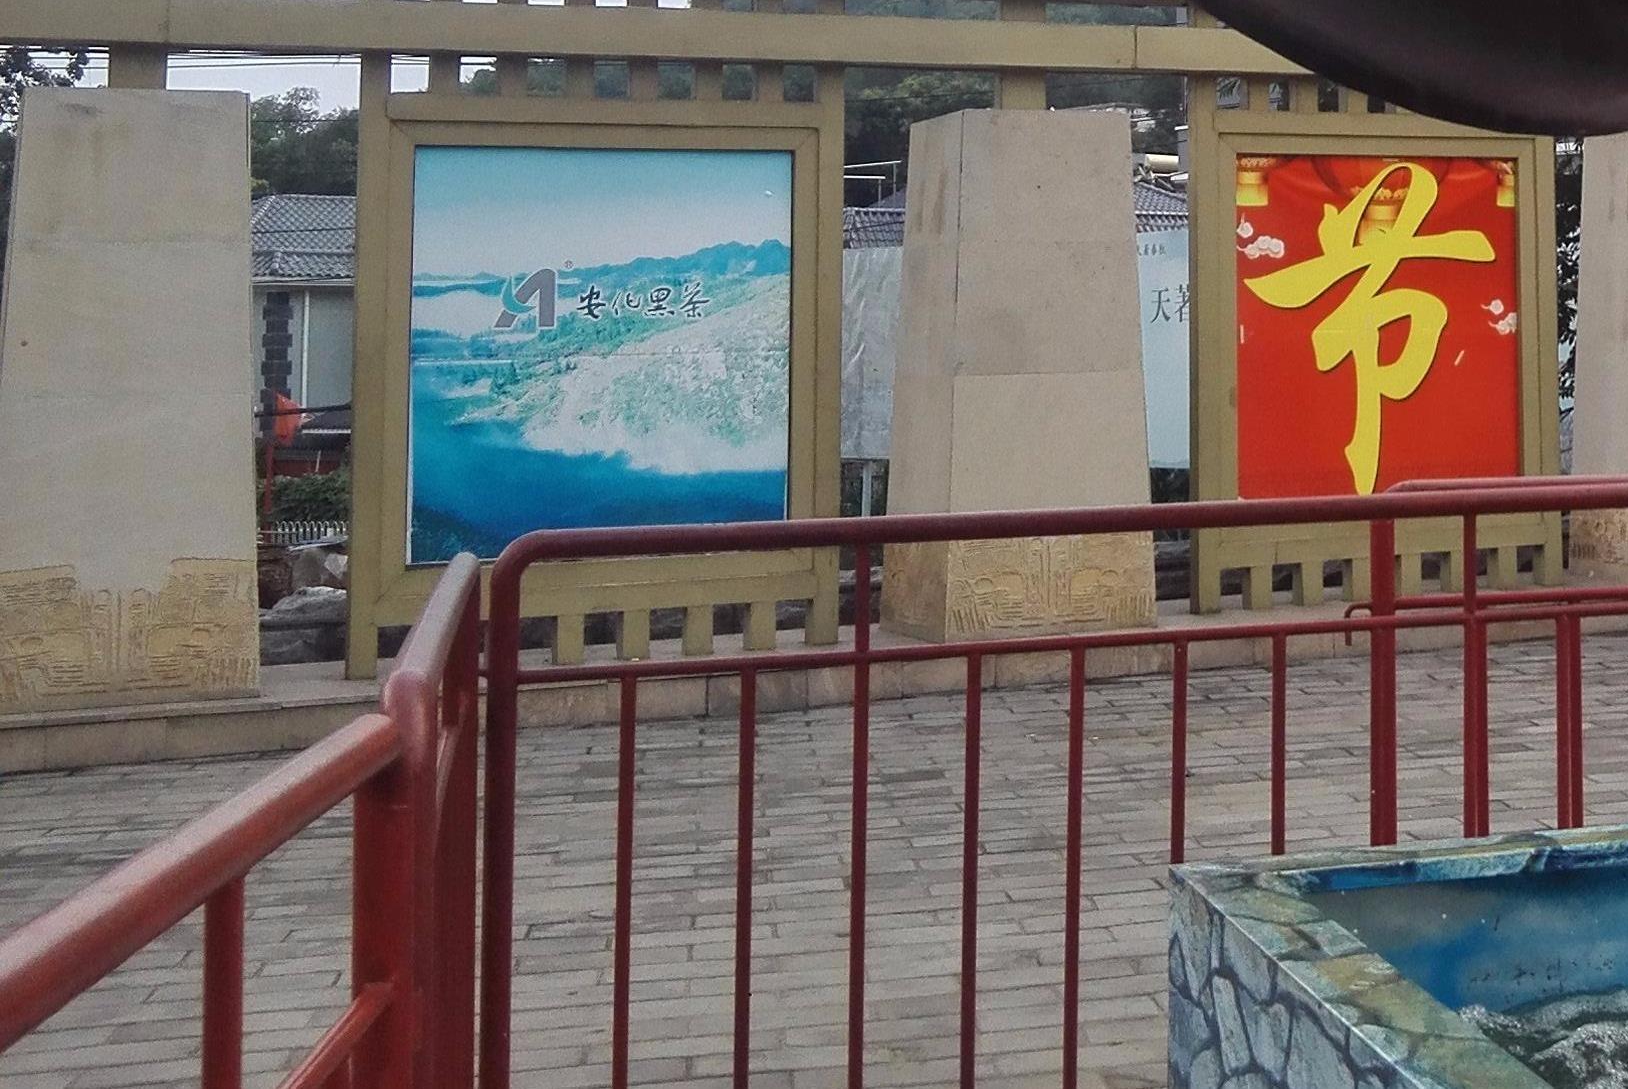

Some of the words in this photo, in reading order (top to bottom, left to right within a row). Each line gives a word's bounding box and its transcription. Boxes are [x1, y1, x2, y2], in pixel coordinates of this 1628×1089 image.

[576, 281, 710, 319] 安化黑茶
[1243, 162, 1497, 496] 节
